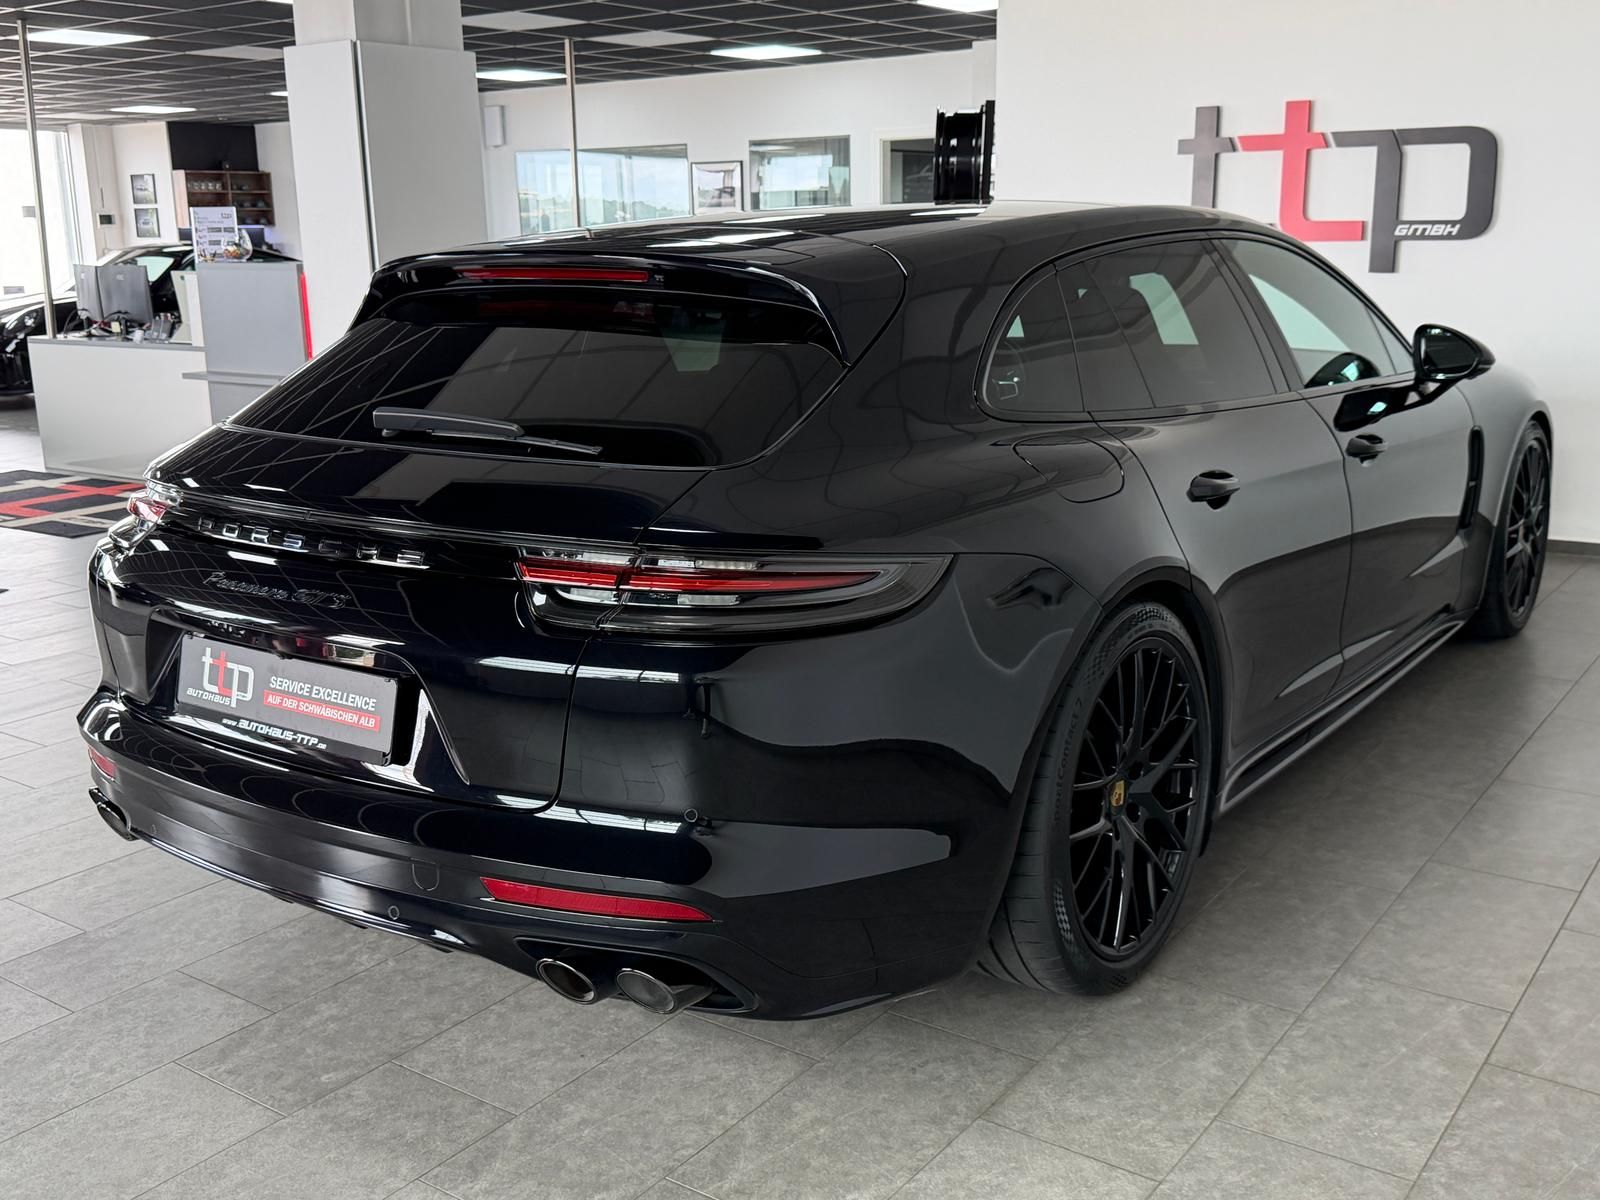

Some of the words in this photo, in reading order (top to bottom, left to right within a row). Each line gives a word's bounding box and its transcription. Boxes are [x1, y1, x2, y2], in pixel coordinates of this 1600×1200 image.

[198, 517, 426, 567] PORSCHE
[267, 694, 282, 705] AUF
[282, 698, 298, 709] DER
[298, 701, 360, 723] SCHWÄBISCHEN
[359, 717, 376, 728] ALB
[269, 676, 311, 696] SERVICE
[311, 685, 377, 711] EXCELLENCE
